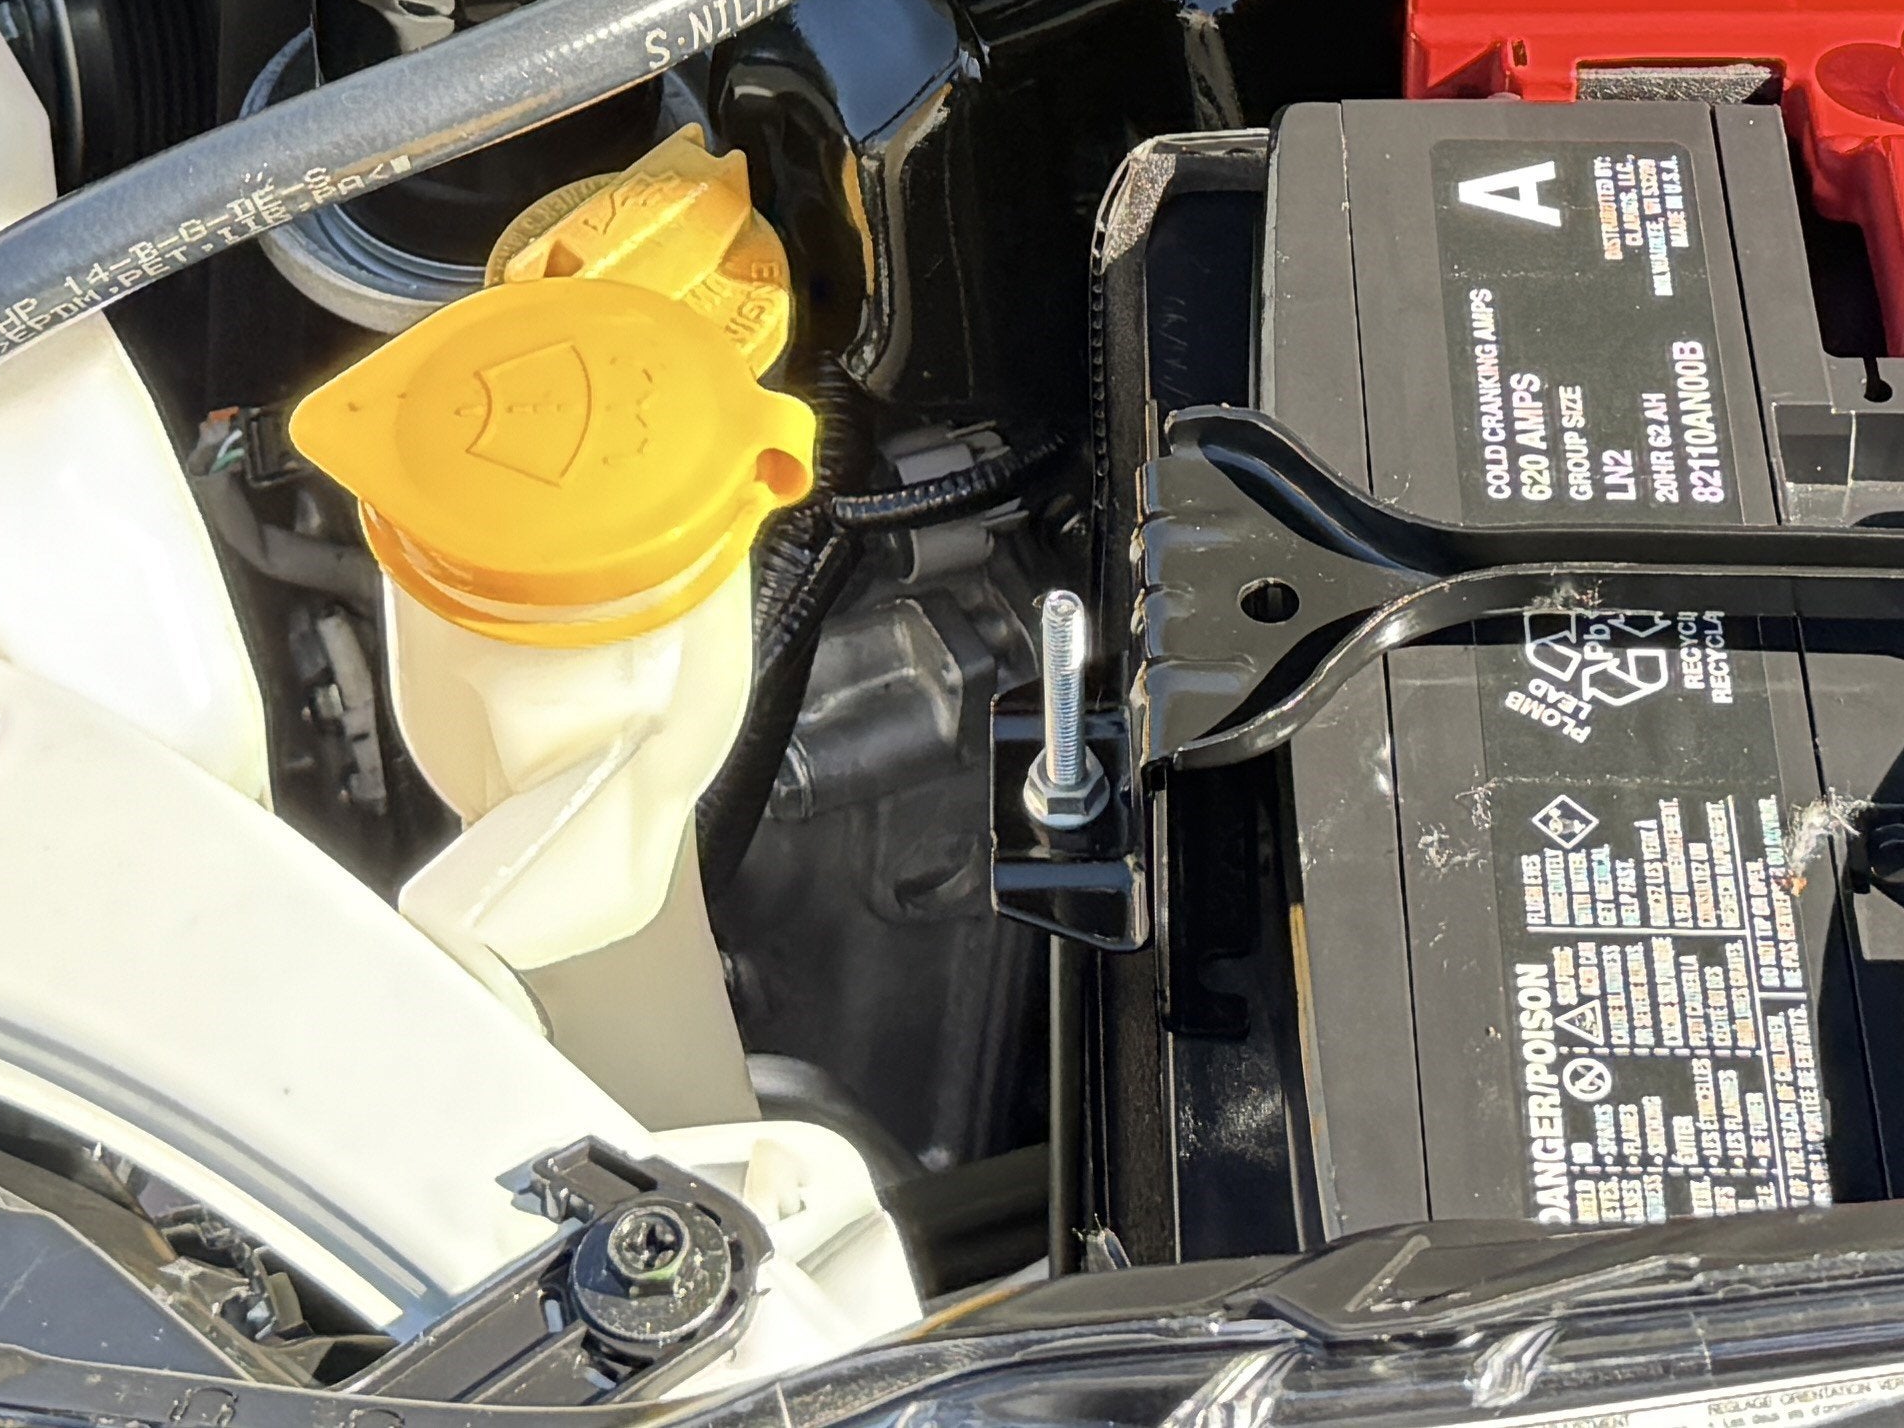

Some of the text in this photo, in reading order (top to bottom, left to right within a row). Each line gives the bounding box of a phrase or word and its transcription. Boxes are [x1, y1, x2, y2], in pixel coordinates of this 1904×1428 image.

[1458, 161, 1562, 227] A
[1660, 155, 1689, 247] MADE IN U.S.A.
[1470, 288, 1512, 499] COLD CRANKING AMPS
[1510, 373, 1553, 500] 620 AMPS
[1672, 341, 1725, 503] 82110AN00B
[1559, 385, 1593, 500] GROUP SIZE
[1602, 450, 1636, 500] LN2
[1642, 393, 1679, 502] 20HR 62 AH
[1583, 624, 1613, 660] Pb
[1504, 691, 1591, 743] PLOMB
[1528, 678, 1592, 720] LEAD
